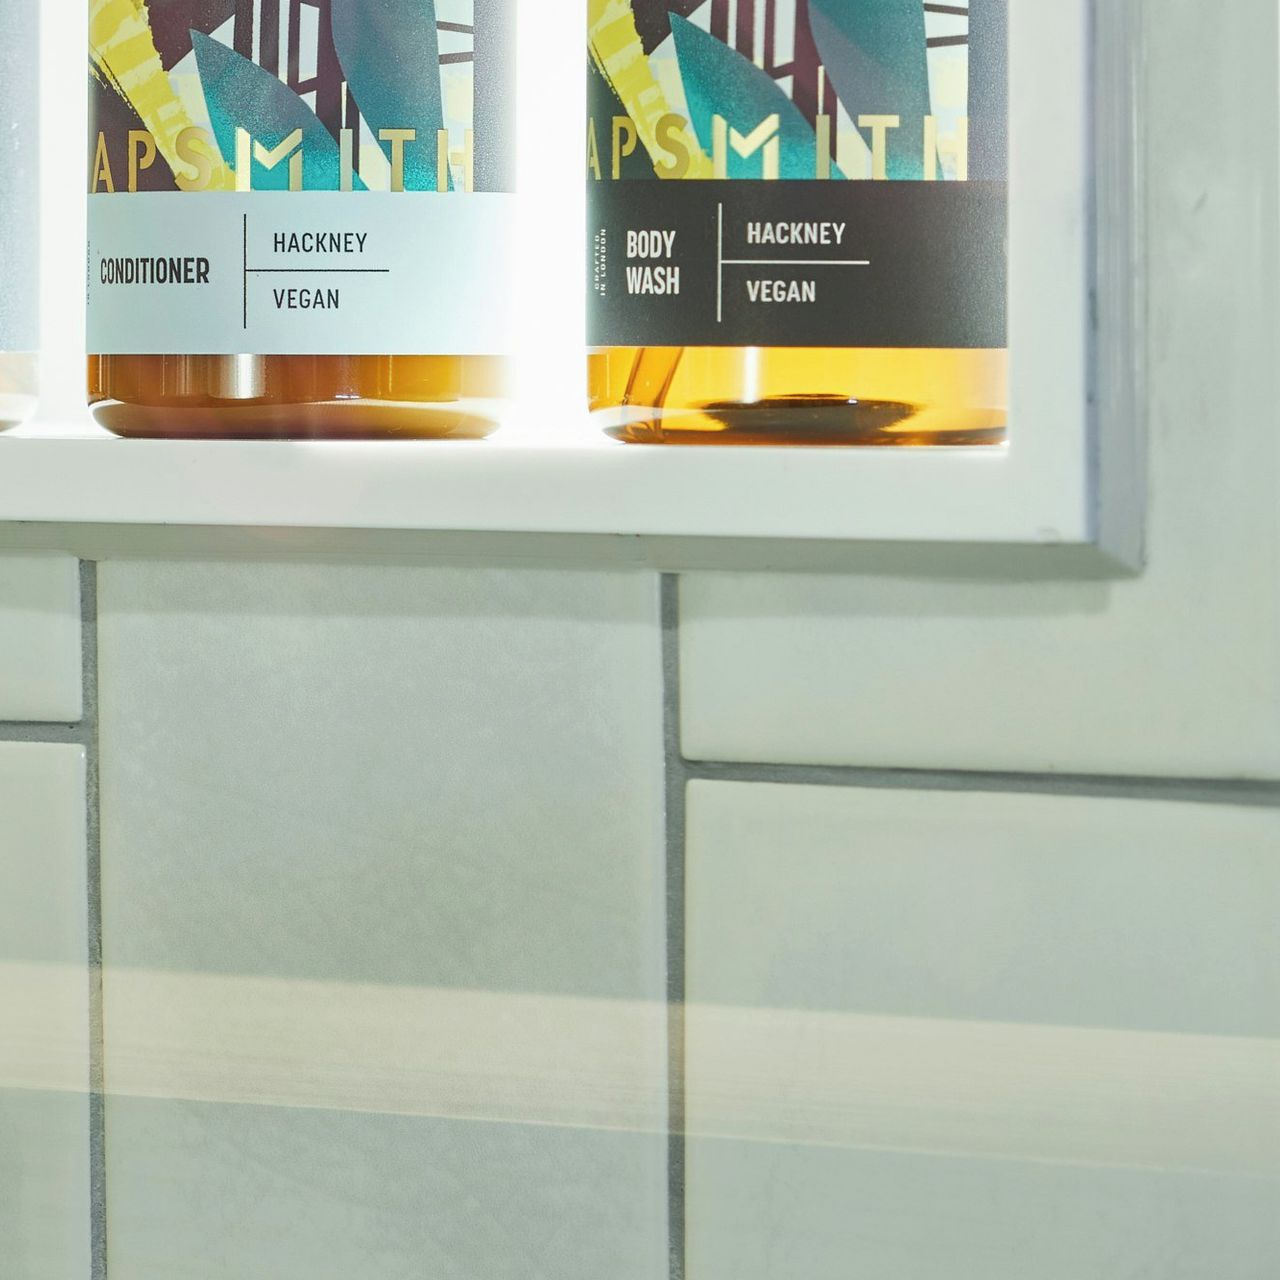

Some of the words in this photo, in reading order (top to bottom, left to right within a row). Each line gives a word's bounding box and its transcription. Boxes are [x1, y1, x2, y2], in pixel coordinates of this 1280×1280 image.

[273, 232, 368, 253] HACKNEY
[626, 229, 676, 259] BODY
[747, 222, 846, 245] HACKNEY
[100, 257, 210, 284] CONDITIONER
[625, 265, 680, 295] WASH
[273, 288, 340, 309] VEGAN
[746, 280, 816, 302] VEGAN
